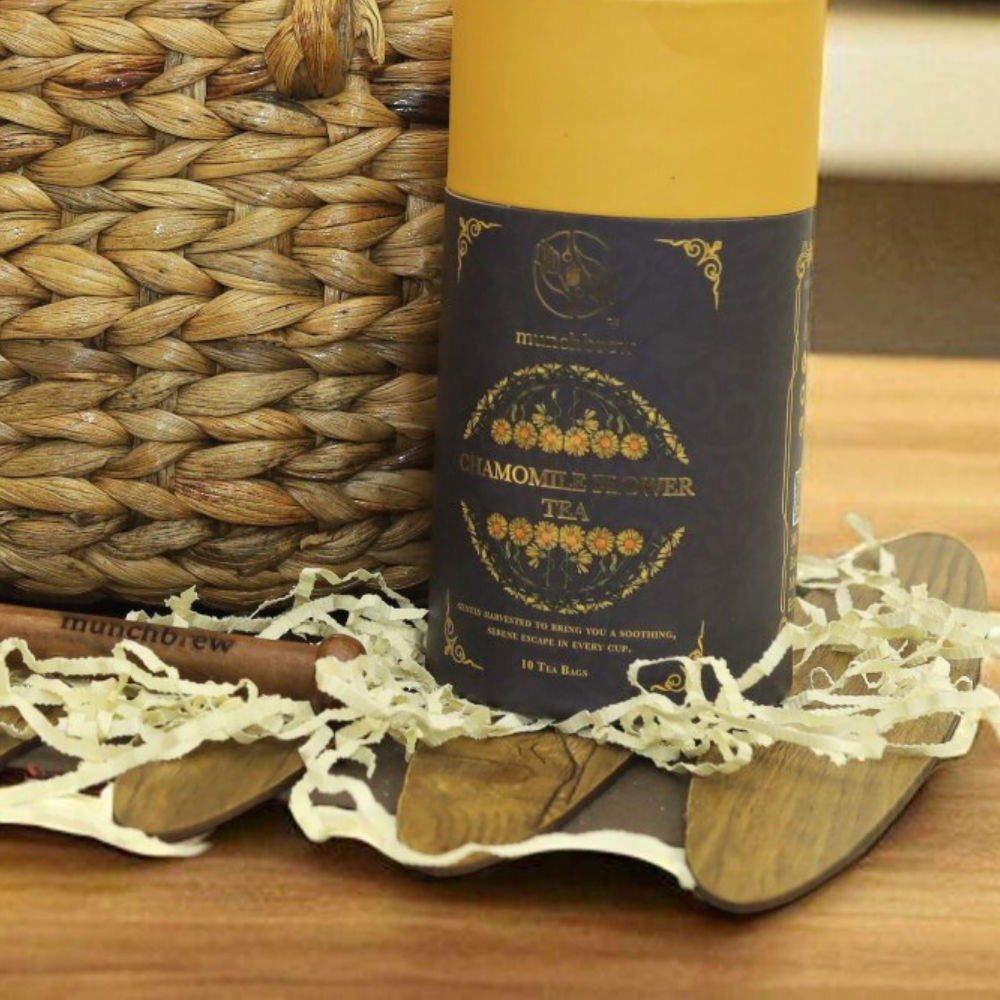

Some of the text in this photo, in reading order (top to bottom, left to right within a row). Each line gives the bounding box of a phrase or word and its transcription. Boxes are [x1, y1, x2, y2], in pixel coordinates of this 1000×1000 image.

[459, 453, 586, 492] CHAMOMILE
[541, 498, 590, 522] TEA
[60, 615, 236, 654] munchbrew
[535, 621, 548, 630] TO
[550, 623, 582, 635] BRING
[586, 626, 607, 636] YOU
[609, 629, 617, 638] A
[619, 629, 677, 640] SOOTHING,
[521, 633, 555, 647] ESCAPE
[558, 639, 569, 648] IN
[572, 641, 605, 652] EVERY
[521, 659, 534, 671] 10
